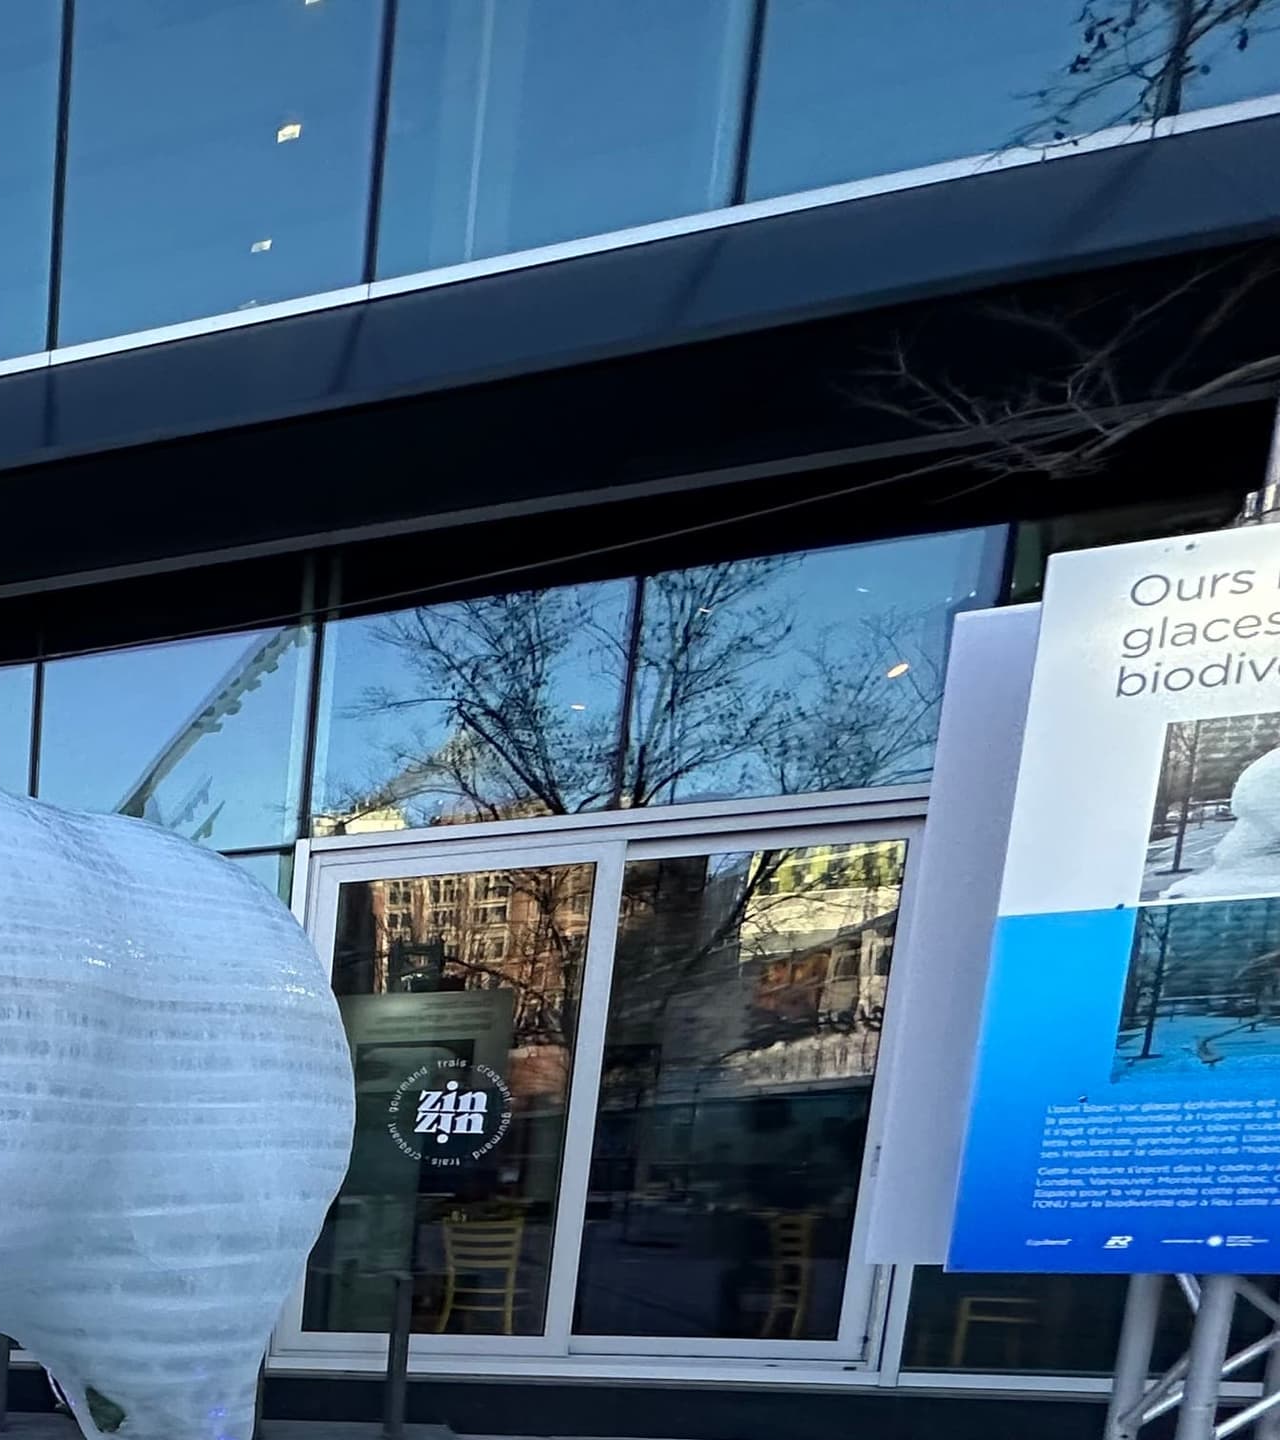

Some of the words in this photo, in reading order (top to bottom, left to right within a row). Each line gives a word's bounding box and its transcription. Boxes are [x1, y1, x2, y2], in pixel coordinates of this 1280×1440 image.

[1130, 570, 1256, 606] Ours
[1116, 652, 1280, 698] biodiv
[388, 1066, 428, 1112] gourmand
[417, 1081, 488, 1112] zin
